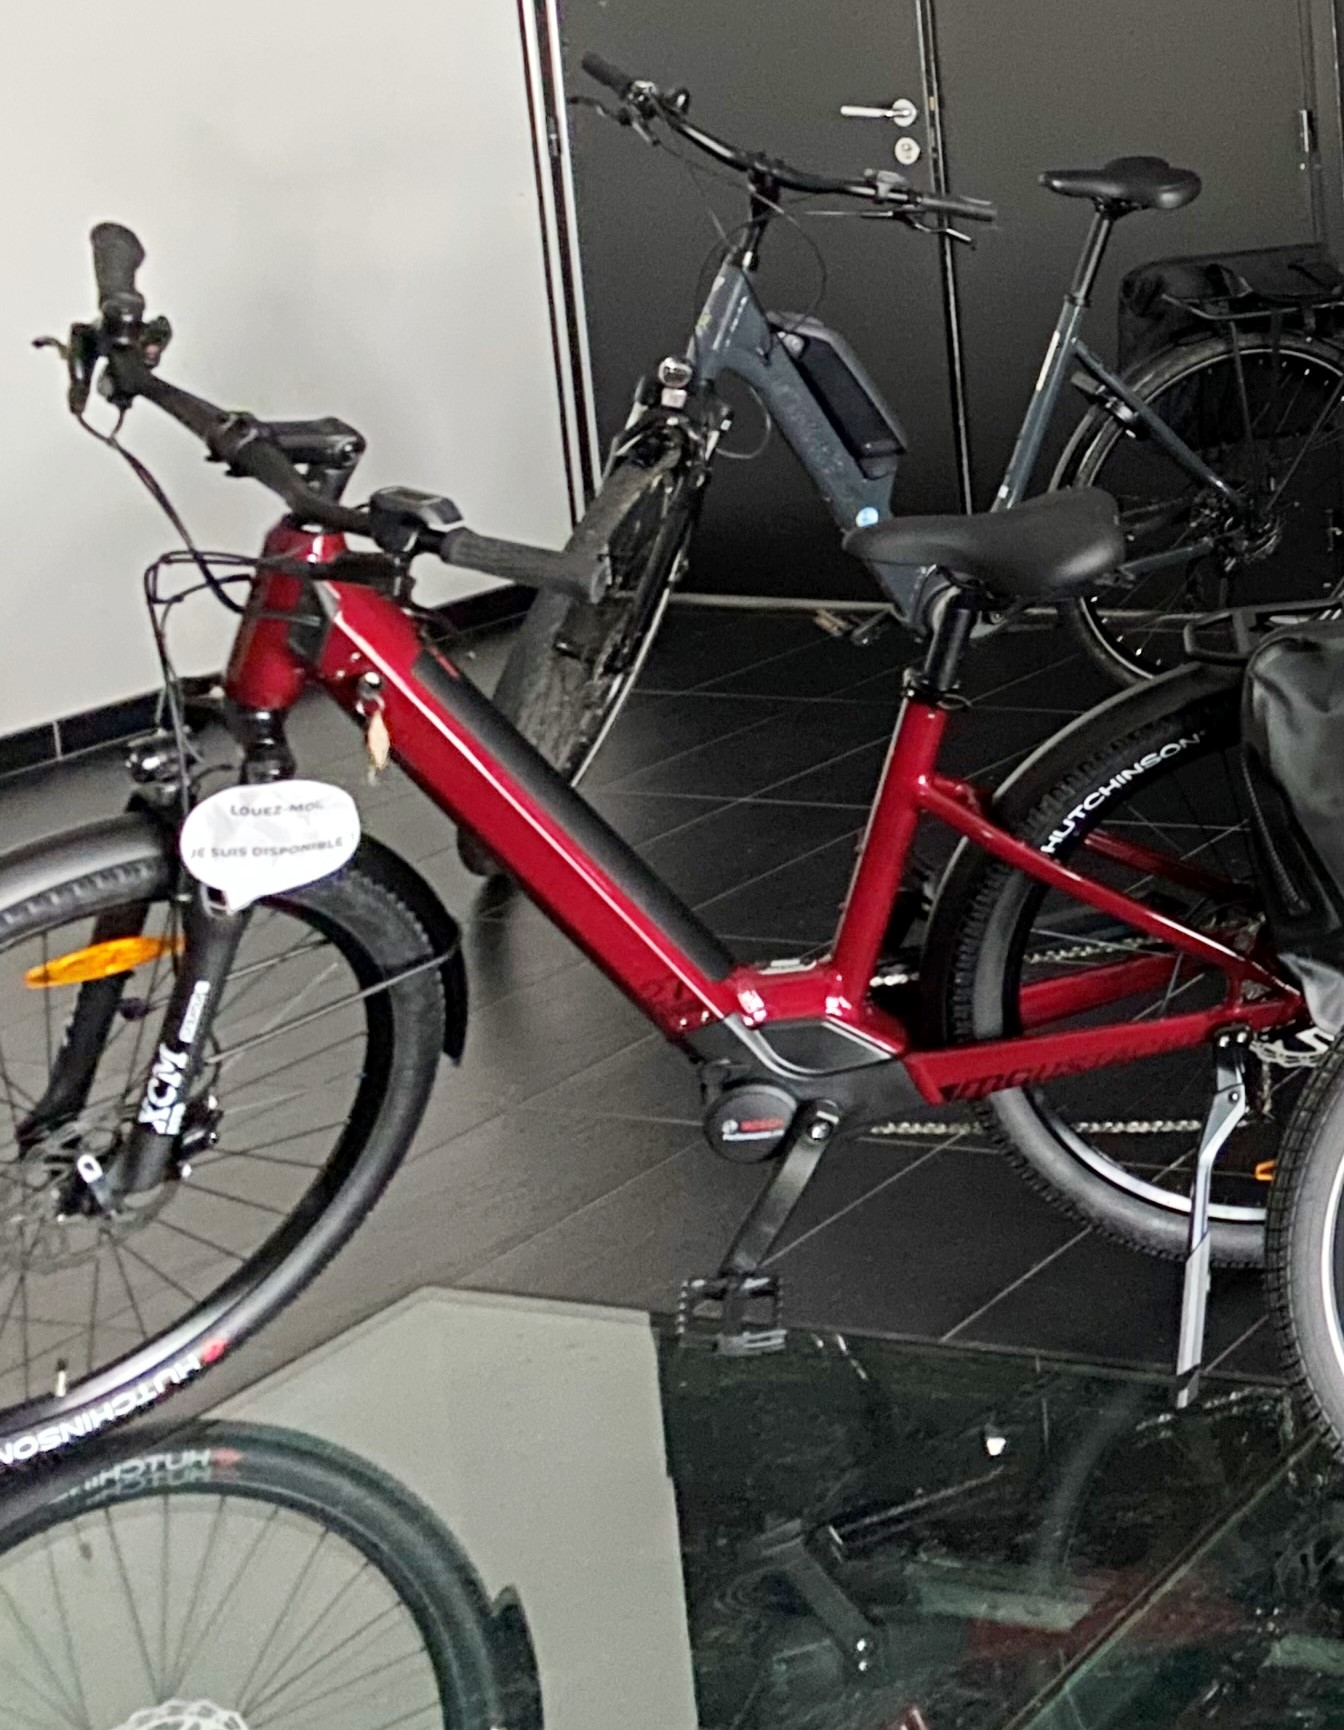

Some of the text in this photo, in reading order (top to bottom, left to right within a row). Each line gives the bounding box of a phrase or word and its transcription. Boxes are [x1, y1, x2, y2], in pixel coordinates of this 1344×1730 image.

[1040, 733, 1202, 854] HUTCHINSON
[191, 848, 205, 860] JE
[211, 847, 248, 858] SUIS
[251, 836, 344, 857] DISPONIBLE
[138, 1042, 189, 1134] XCM
